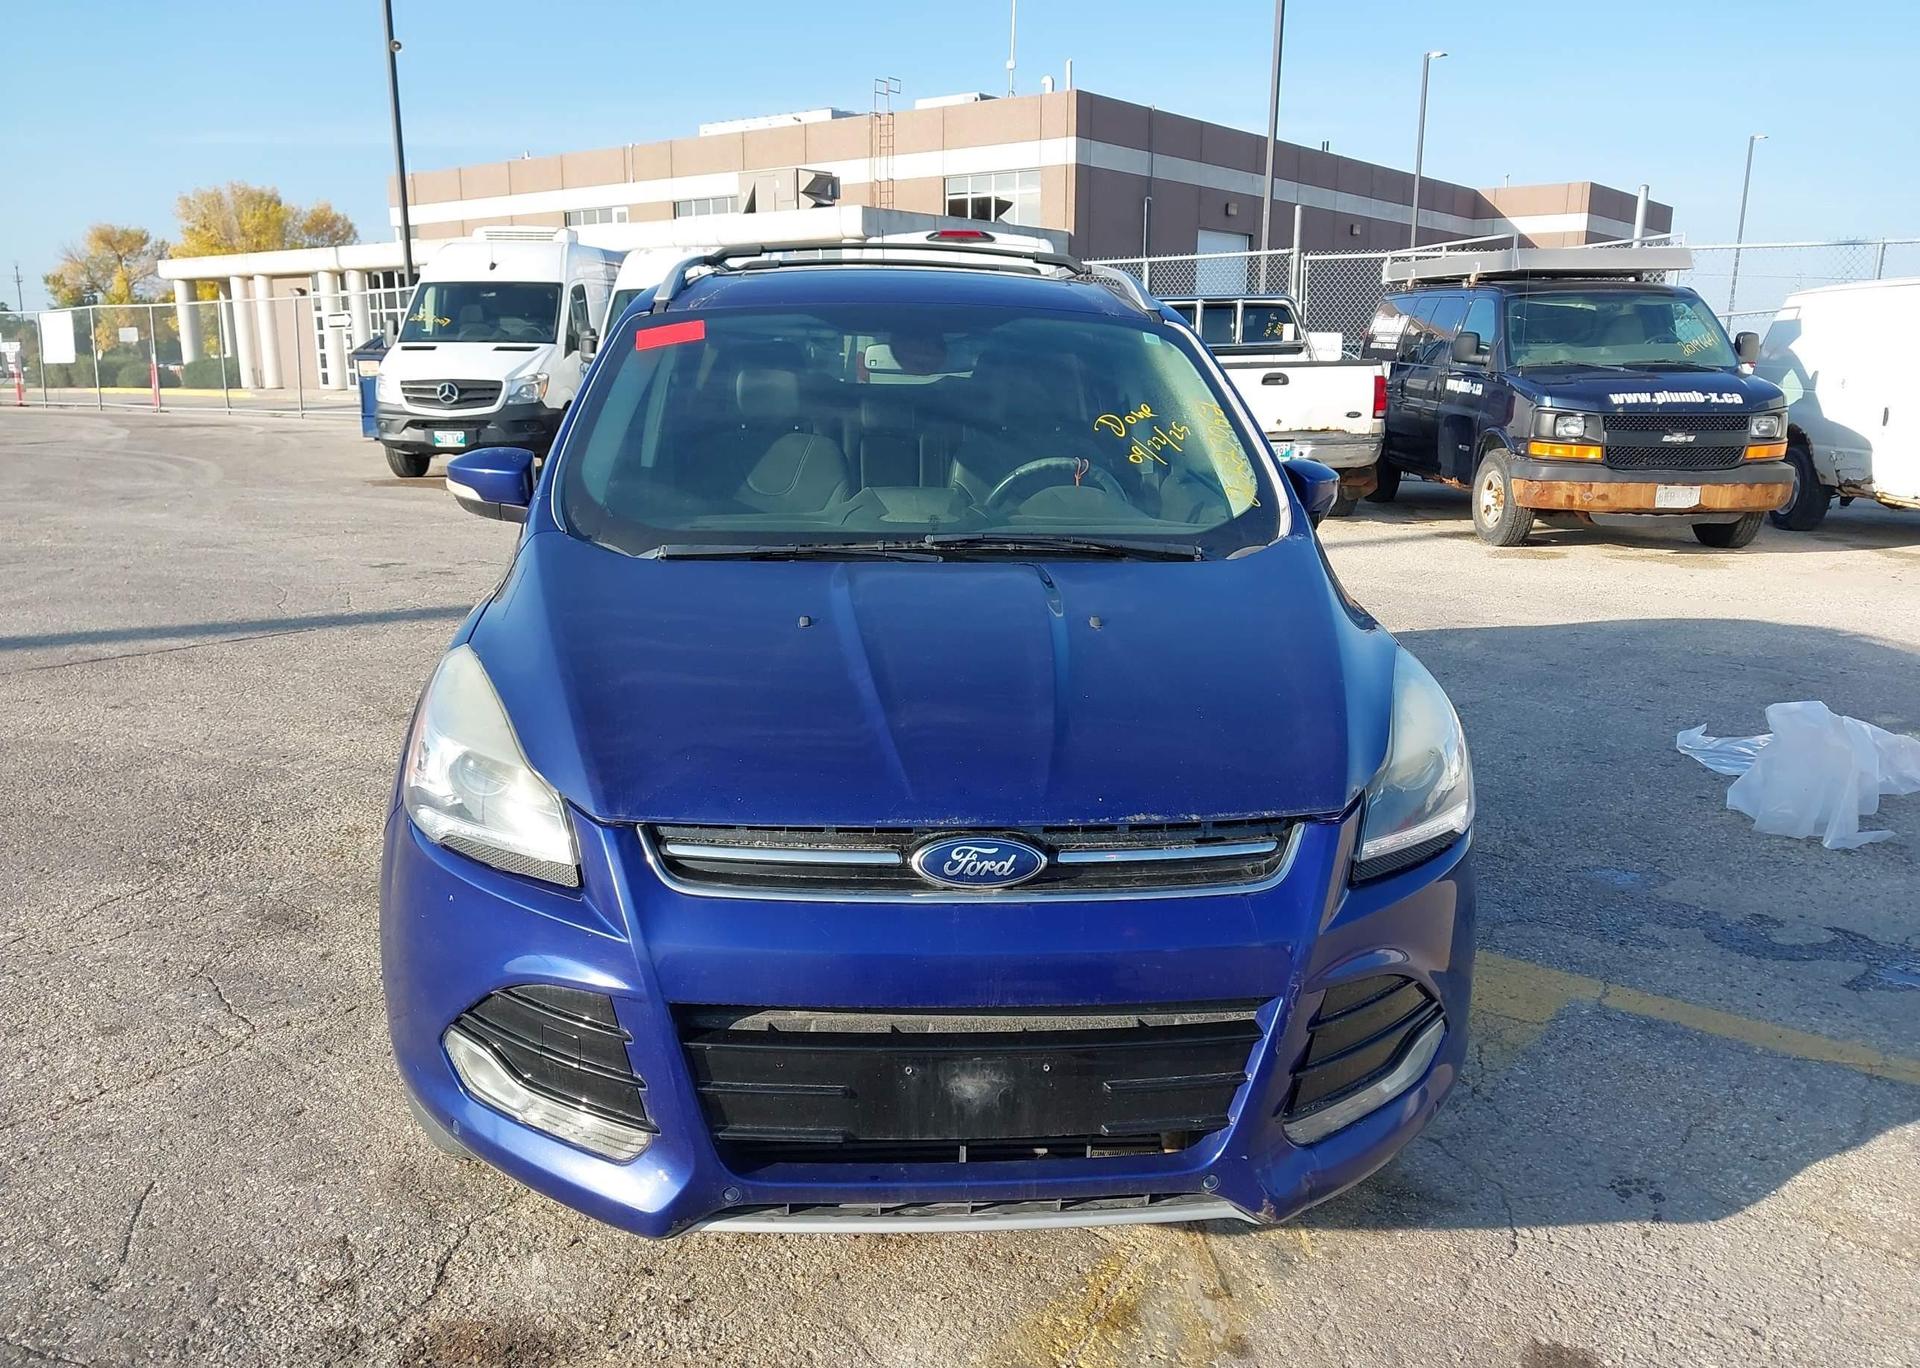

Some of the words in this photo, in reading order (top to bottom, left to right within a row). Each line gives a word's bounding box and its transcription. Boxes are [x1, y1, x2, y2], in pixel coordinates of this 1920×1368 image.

[1608, 390, 1744, 405] www.plumb-x.ca
[1094, 403, 1159, 437] Done
[1127, 421, 1192, 465] 09/22/25
[943, 845, 1017, 877] Ford
